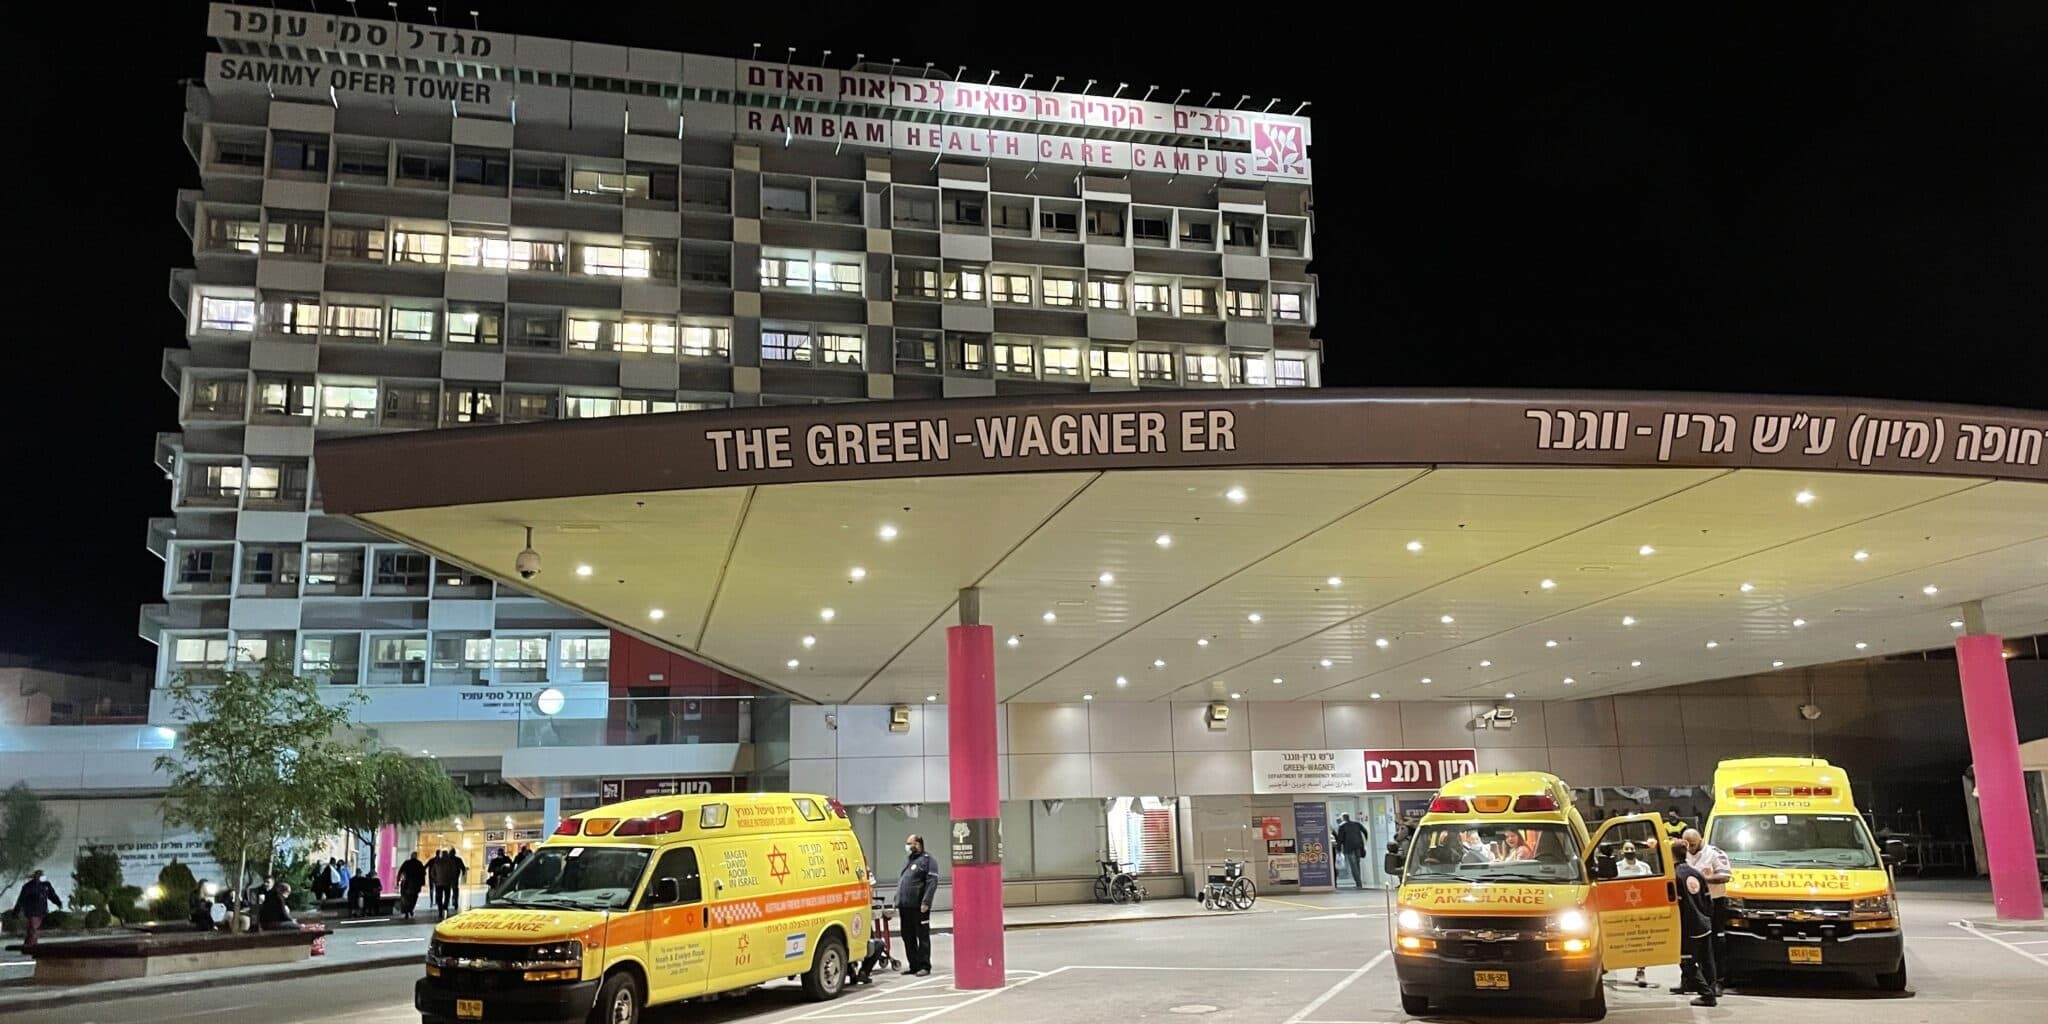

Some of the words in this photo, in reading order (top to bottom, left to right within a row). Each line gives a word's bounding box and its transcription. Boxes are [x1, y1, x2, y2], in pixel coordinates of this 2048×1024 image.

[224, 9, 308, 37] עופר
[325, 20, 388, 45] סמי
[407, 25, 492, 57] מגדל
[219, 58, 321, 88] SAMMY
[330, 69, 396, 95] OFER
[404, 76, 492, 104] TOWER
[747, 67, 824, 93] האדם
[839, 76, 945, 105] לבריאות
[954, 87, 1060, 118] הרפואית
[1069, 100, 1144, 128] הקריה
[1173, 110, 1246, 135] רמב״ם
[748, 111, 885, 143] RAMBAM
[906, 127, 1019, 156] HEALTH
[1040, 139, 1112, 164] CARE
[1133, 148, 1247, 176] CAMPUS
[705, 426, 794, 473] THE
[805, 411, 1167, 469] GREEN-WAGNER
[1180, 409, 1238, 453] ER
[1750, 412, 1837, 456] ע״ש
[1846, 413, 1945, 467] (מיון)
[1955, 423, 2048, 466] חופה
[1366, 758, 1433, 783] רמב״ם
[1438, 759, 1475, 788] מיון
[723, 849, 748, 859] MAGEN
[726, 859, 747, 869] DAVID
[836, 858, 850, 875] 104
[728, 868, 748, 878] ADOM
[737, 877, 760, 887] ISRAEL
[1743, 880, 1852, 889] AMBULANCE
[452, 920, 546, 933] AMBULANCE
[735, 954, 751, 966] 101
